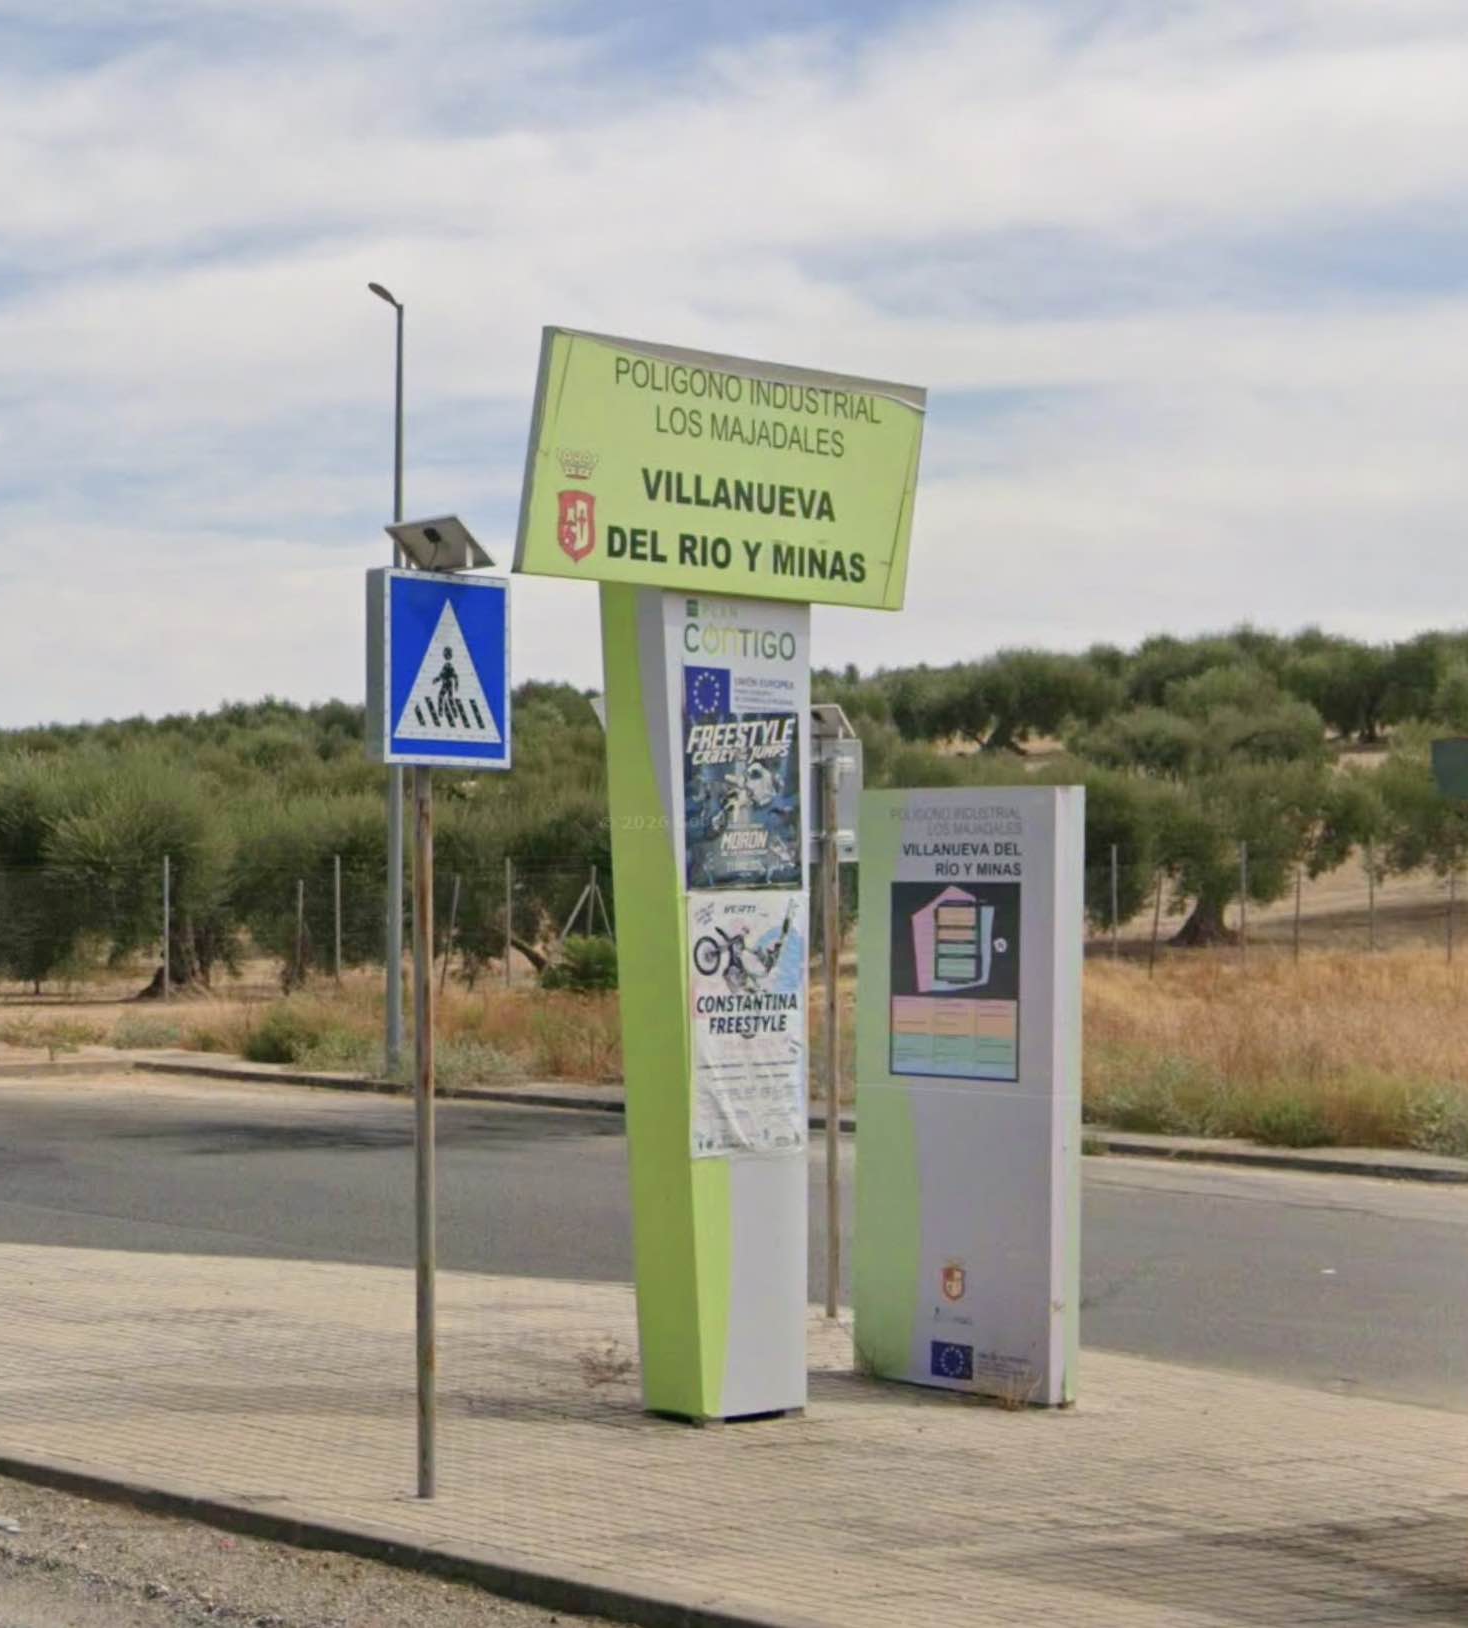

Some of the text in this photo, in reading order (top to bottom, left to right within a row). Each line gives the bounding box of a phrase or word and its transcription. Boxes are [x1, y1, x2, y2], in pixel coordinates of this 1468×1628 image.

[615, 356, 883, 425] POLIGONO INDUSTRIAL
[655, 405, 845, 458] LOS MAJADALES
[641, 467, 836, 523] VILLANUEVA
[606, 525, 867, 583] DEL RIO Y MINAS
[686, 718, 796, 753] FREESTYLE
[902, 842, 1022, 856] VILLANUEVA DEL
[935, 860, 1022, 876] RÍO Y MINAS
[696, 993, 798, 1014] CONSTANTINA
[709, 1014, 787, 1035] FREESTYLE
